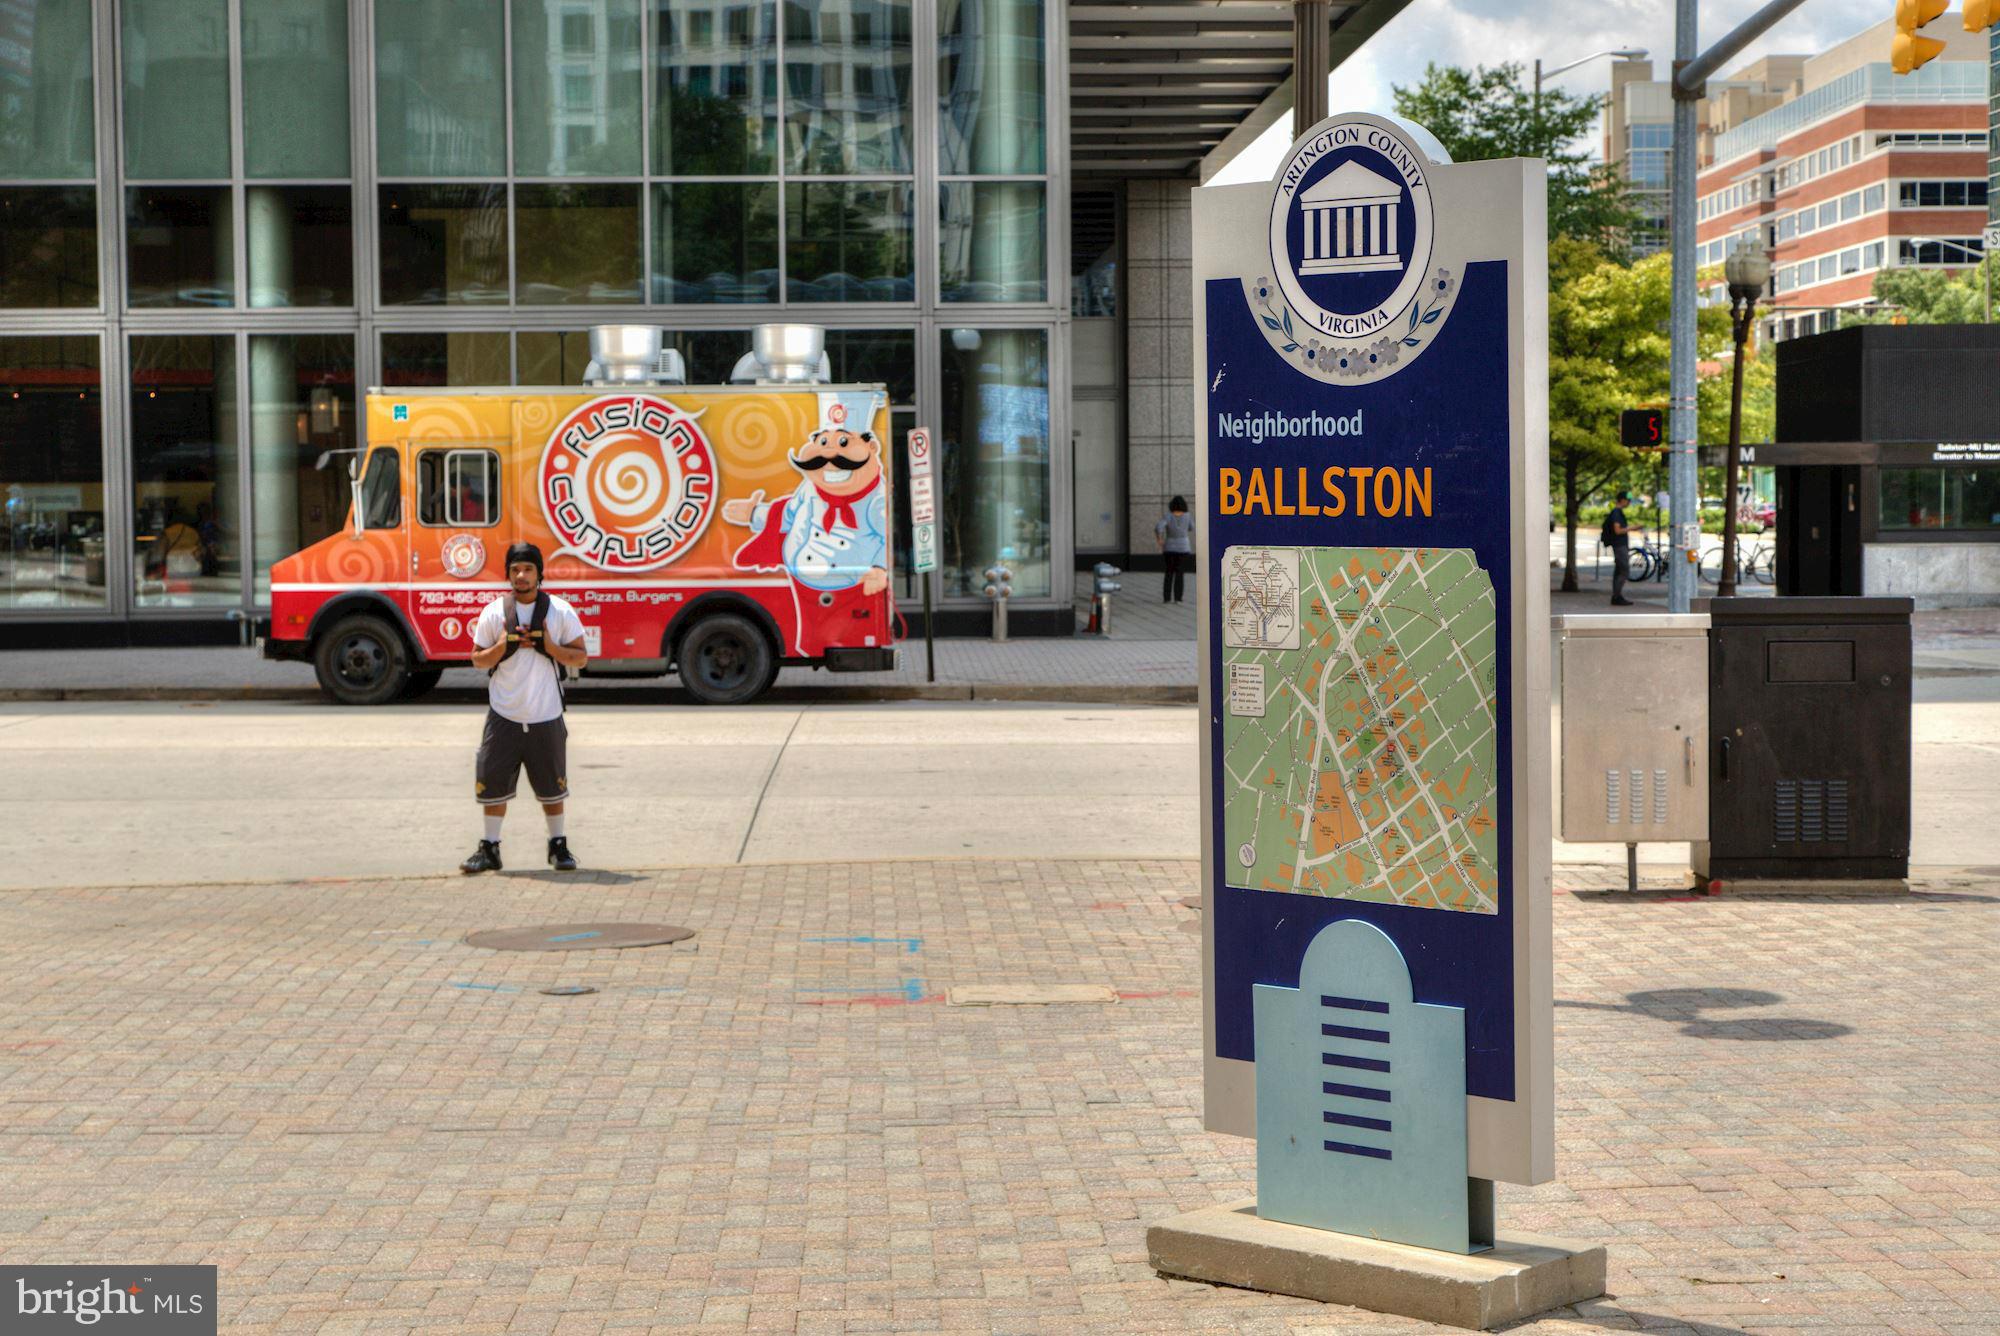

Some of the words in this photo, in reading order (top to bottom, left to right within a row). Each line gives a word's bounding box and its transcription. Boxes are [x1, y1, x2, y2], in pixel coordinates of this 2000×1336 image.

[1282, 127, 1360, 198] ARLINGTON
[1367, 130, 1424, 189] COUNTY
[1318, 308, 1390, 335] VIRGINIA
[1218, 408, 1363, 445] Neighborhood
[1648, 417, 1659, 441] 5
[1739, 447, 1756, 462] M
[1219, 465, 1433, 518] BALLSTON
[584, 590, 624, 603] Pizza,
[626, 590, 683, 605] Burgers
